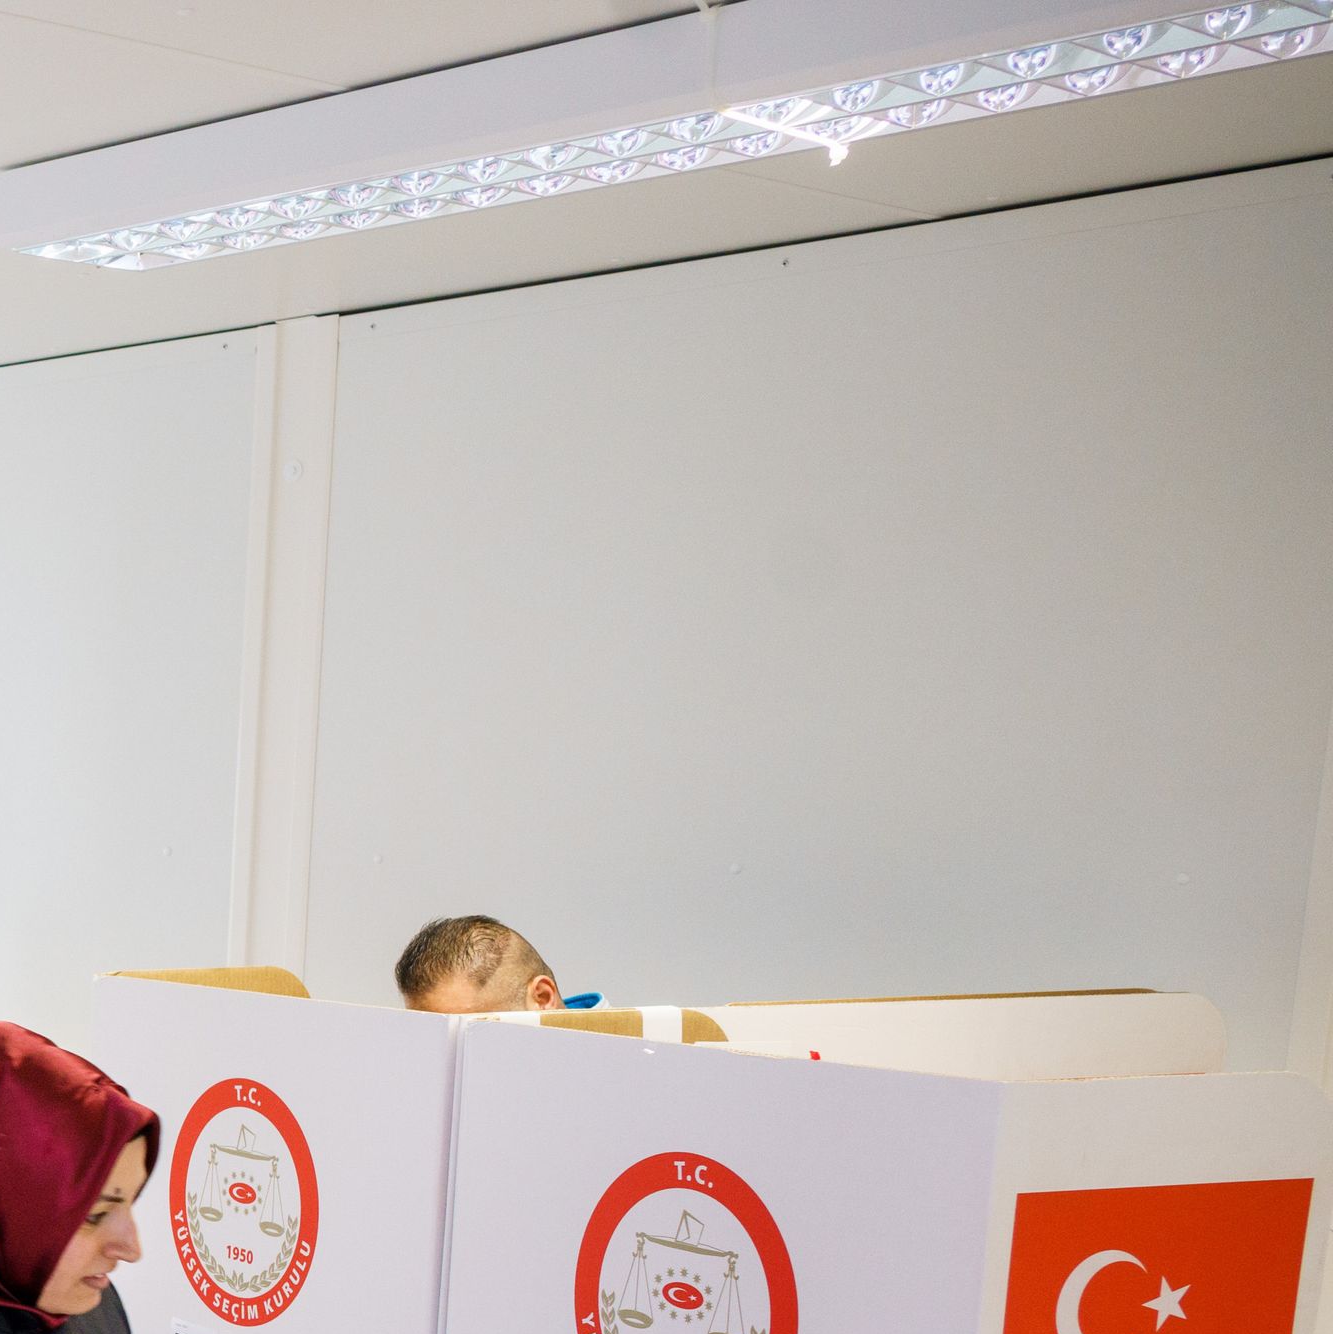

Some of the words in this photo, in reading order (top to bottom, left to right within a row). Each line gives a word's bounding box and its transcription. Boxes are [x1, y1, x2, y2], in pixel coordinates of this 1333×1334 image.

[234, 1085, 261, 1107] T.C.
[674, 1160, 714, 1188] T.C.
[174, 1211, 211, 1297] YÜKSEK
[213, 1293, 258, 1322] SEÇİM
[264, 1239, 310, 1313] KURULU
[226, 1245, 254, 1265] 1950
